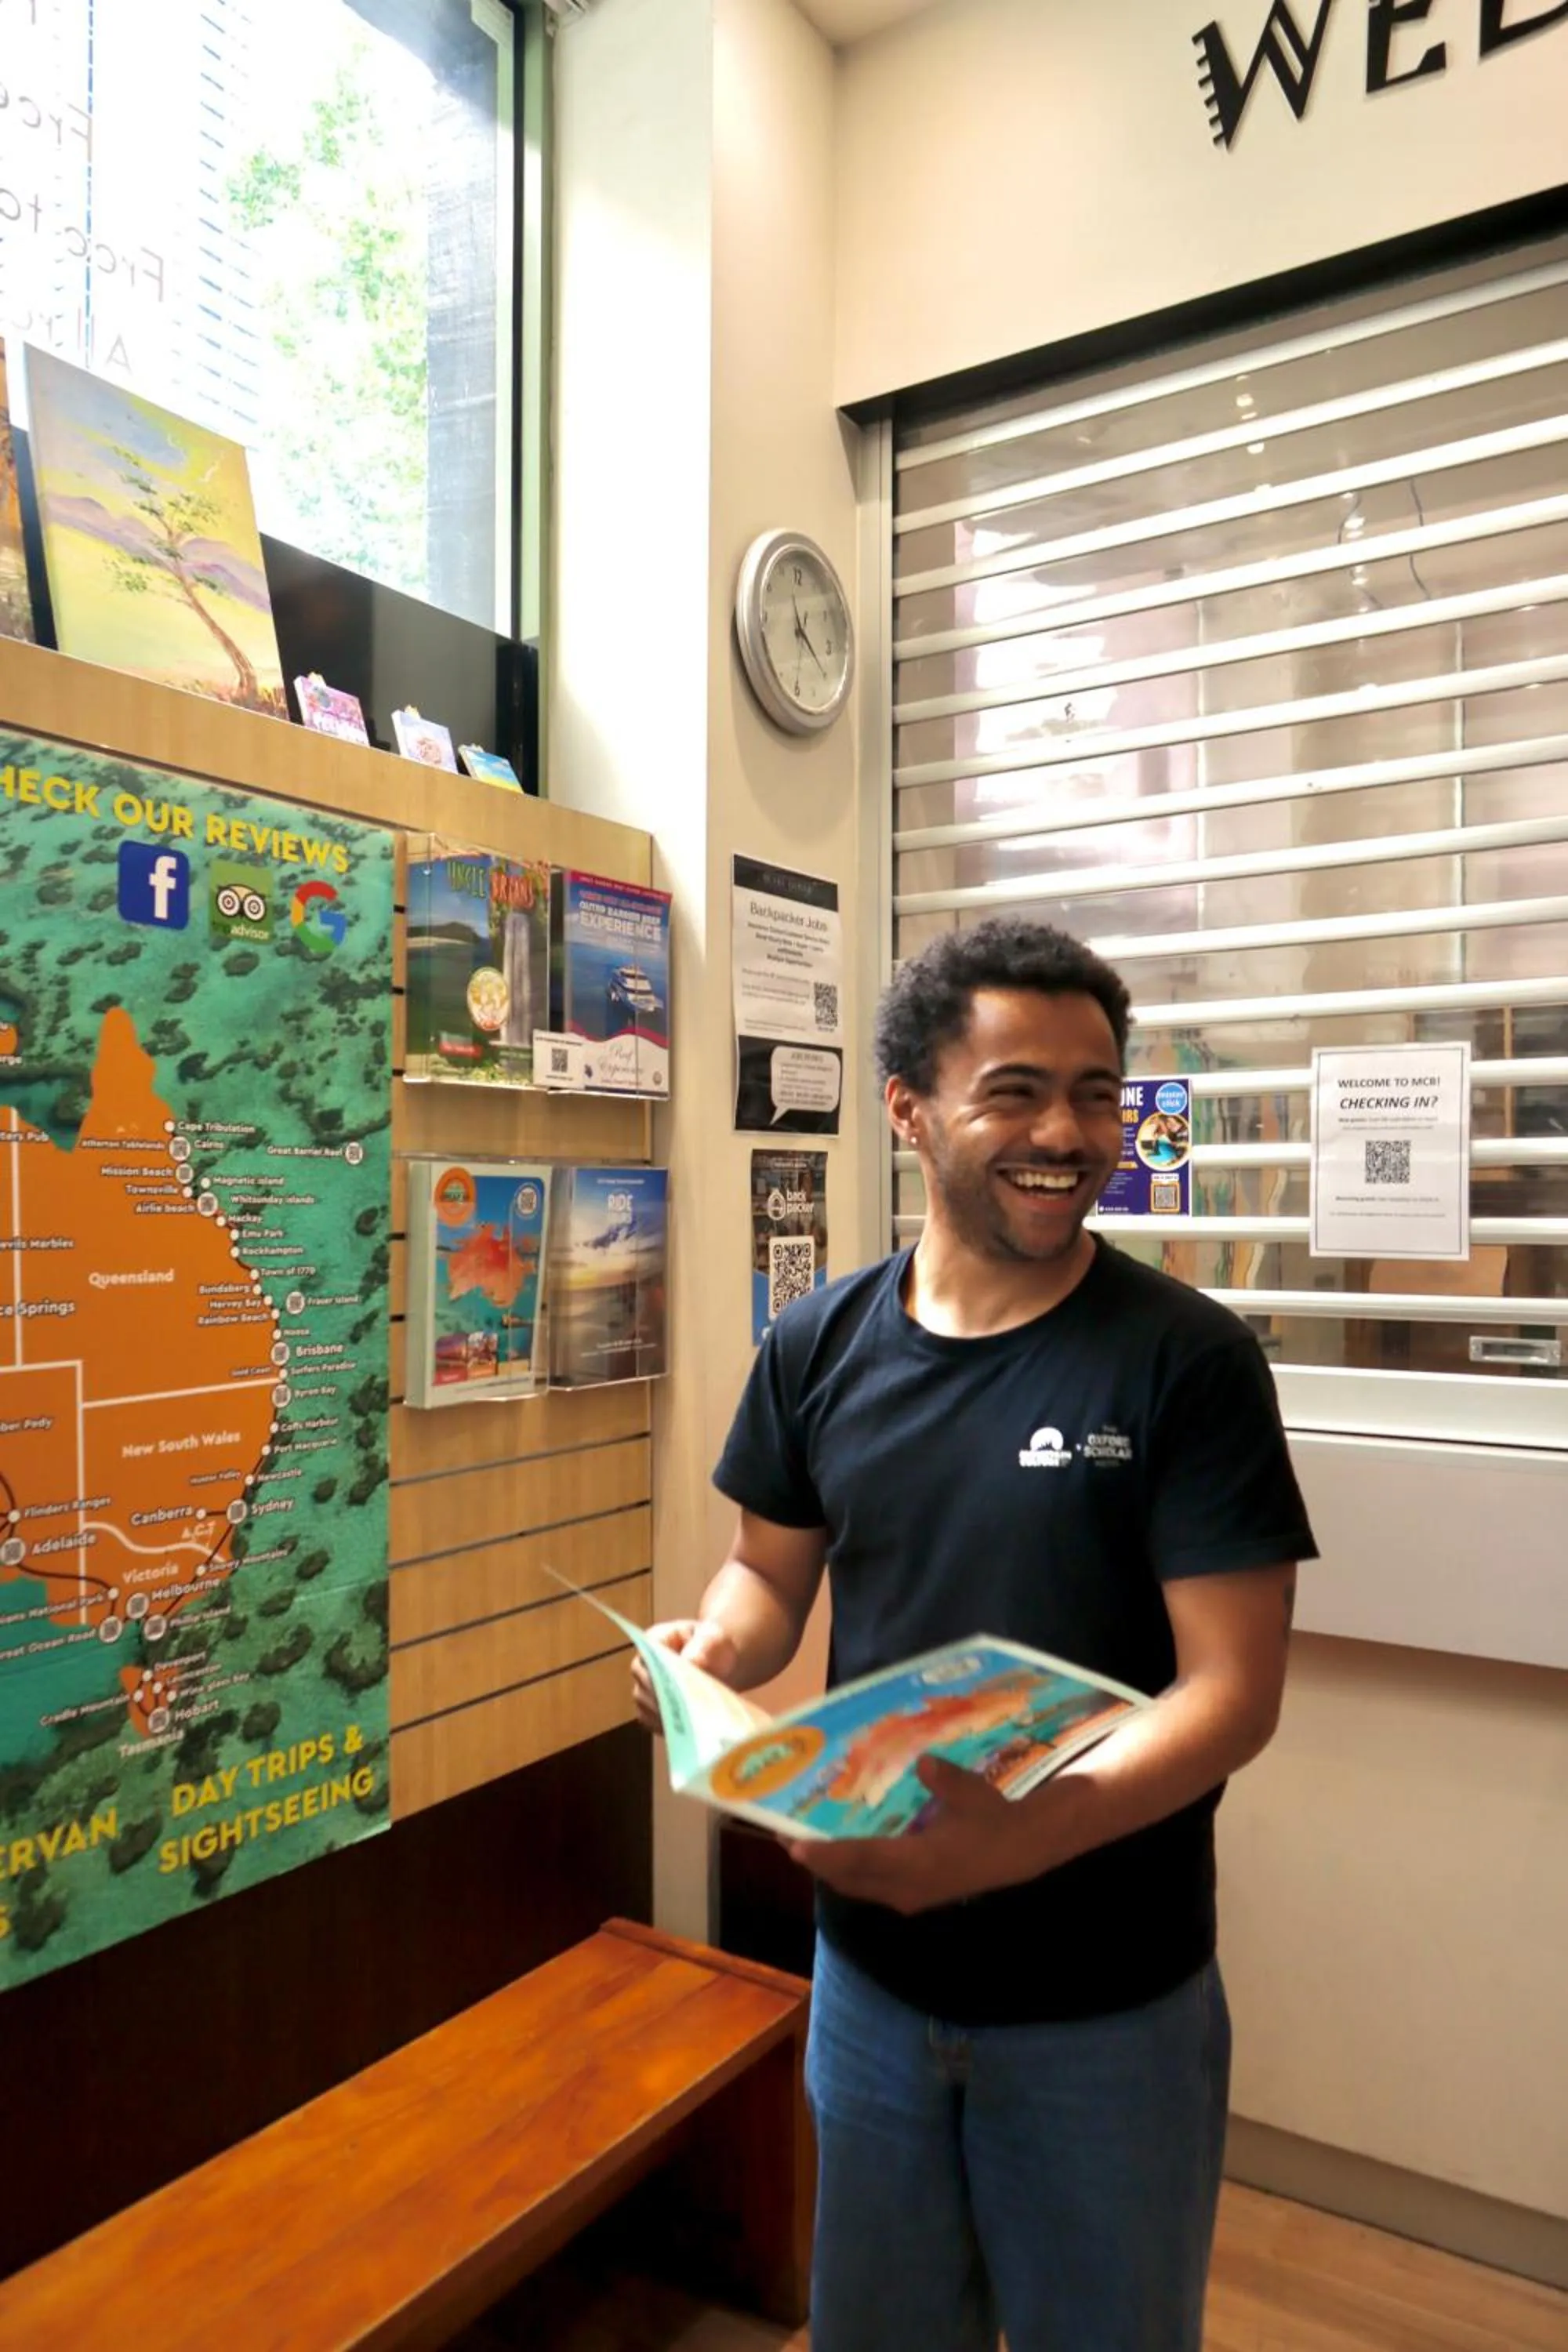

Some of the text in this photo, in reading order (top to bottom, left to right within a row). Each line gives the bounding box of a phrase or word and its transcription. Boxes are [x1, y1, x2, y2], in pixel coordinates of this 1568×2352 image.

[113, 793, 194, 840] OUR
[206, 814, 350, 874] REVIEWS
[1338, 1077, 1391, 1088] WELCOME
[1393, 1077, 1409, 1087] TO
[1340, 1095, 1439, 1110] CHECKING IN?
[88, 1269, 175, 1290] Queensland
[17, 1300, 76, 1317] Springs
[296, 1344, 343, 1357] Brisbane
[122, 1430, 241, 1458] New South Wales
[130, 1504, 194, 1526] Canberra
[31, 1533, 97, 1555] Adelaide
[122, 1562, 180, 1584] Victoria
[151, 1578, 221, 1601] Melbourne
[171, 1726, 365, 1817] DAY TRIPS &
[159, 1767, 375, 1875] SIGHTSEEING
